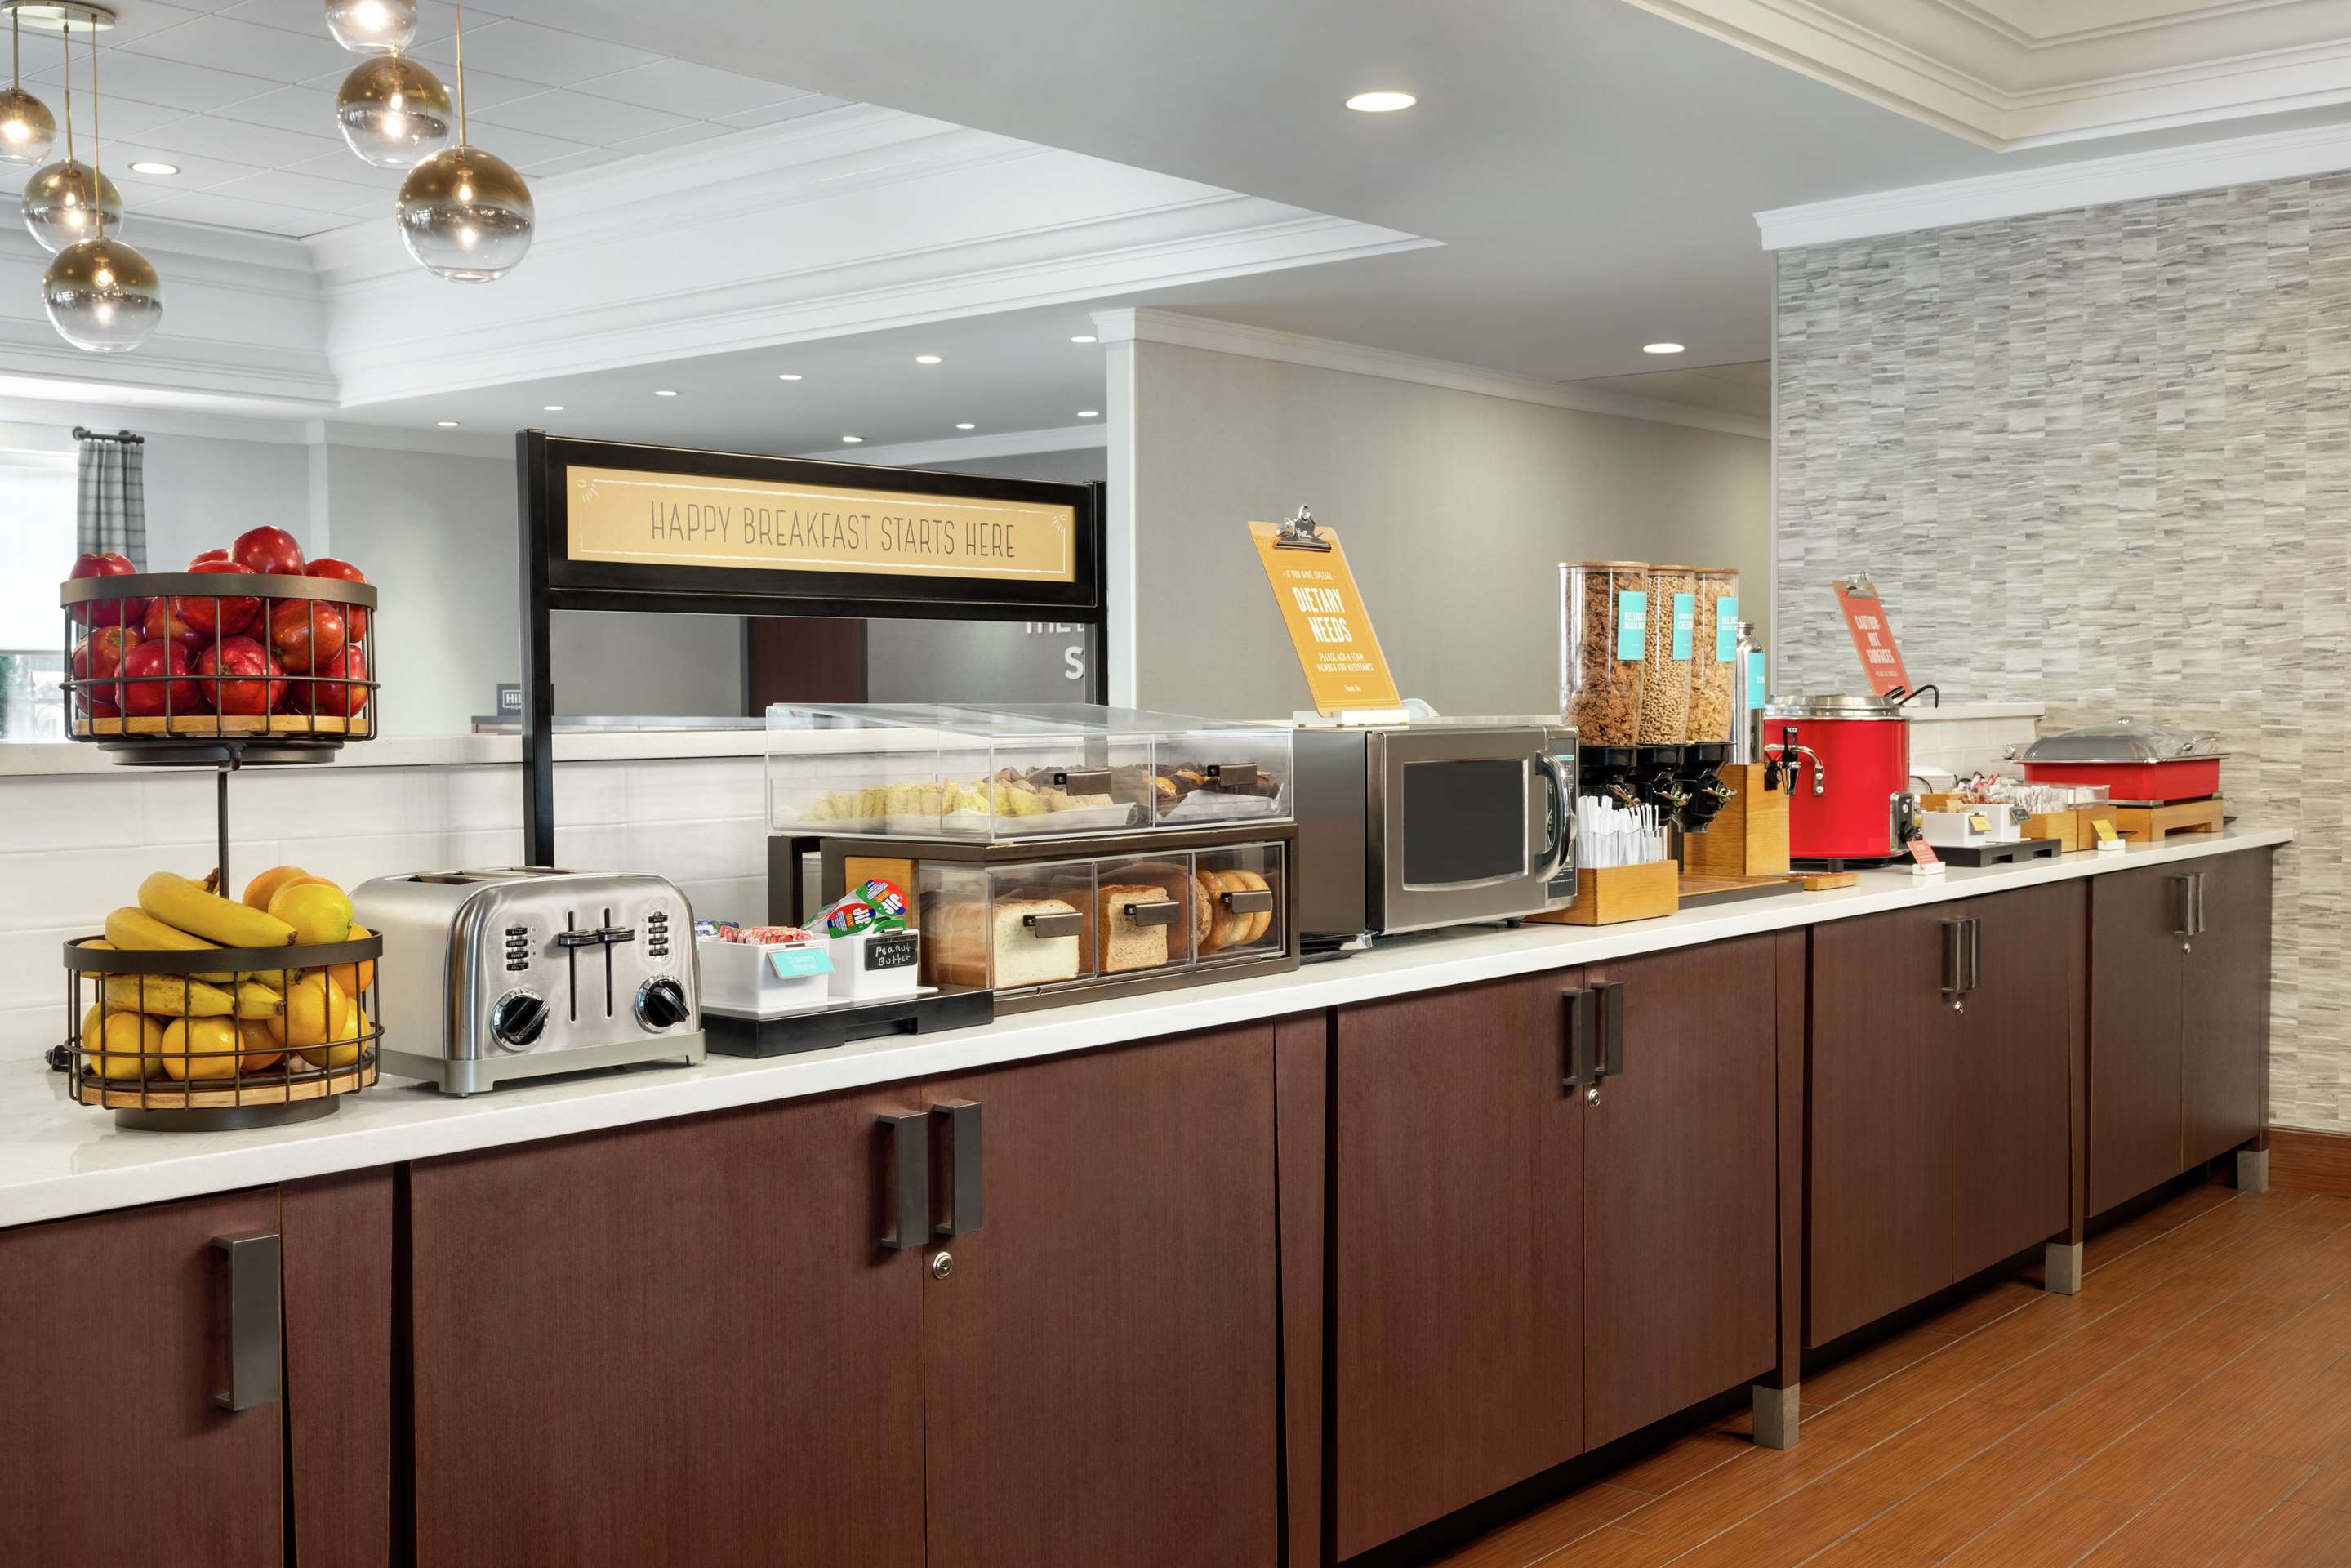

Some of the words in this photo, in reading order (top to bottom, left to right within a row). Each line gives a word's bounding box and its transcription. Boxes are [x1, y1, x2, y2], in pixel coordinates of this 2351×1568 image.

[651, 501, 731, 543] HAPPY
[743, 506, 871, 550] BREAKFAST
[880, 515, 955, 555] STARTS
[965, 521, 1016, 558] HERE
[1292, 587, 1346, 613] DIETARY
[1307, 617, 1353, 644] NEEDS
[881, 893, 903, 915] Jif
[852, 907, 872, 924] Jif
[875, 942, 911, 958] Peanut
[878, 953, 911, 966] Butter
